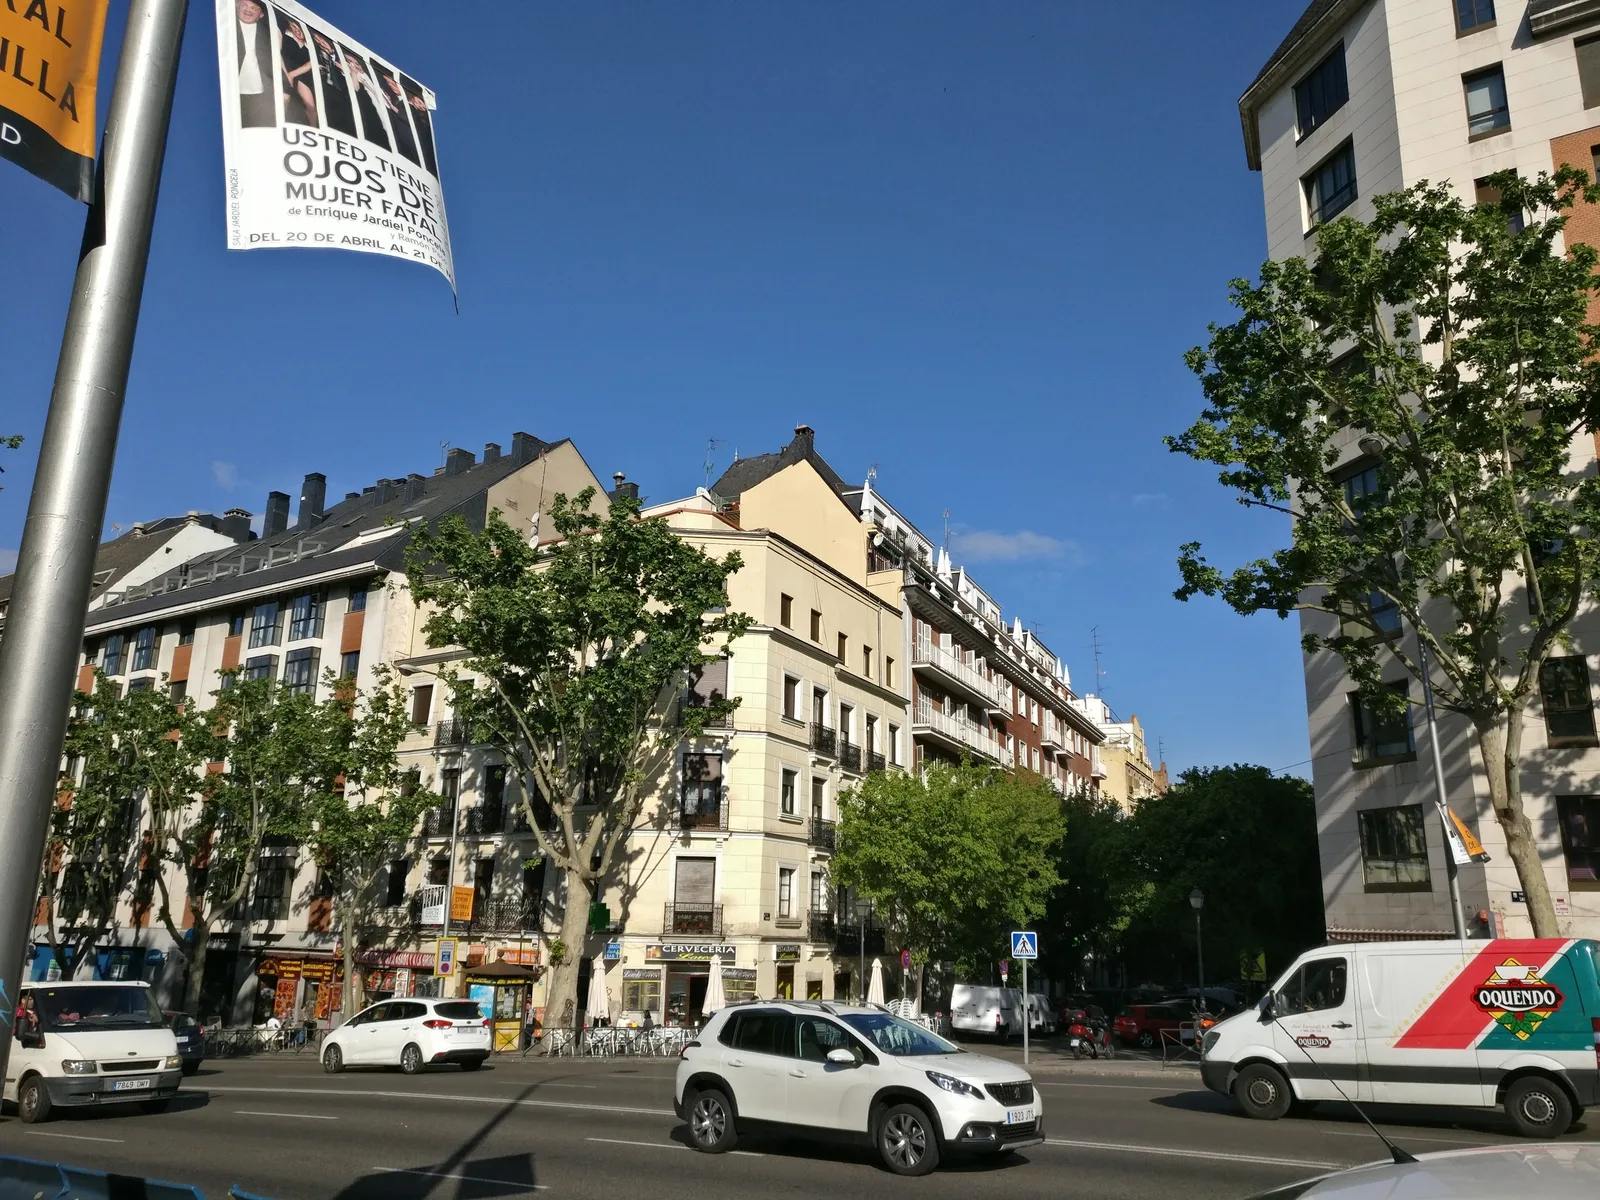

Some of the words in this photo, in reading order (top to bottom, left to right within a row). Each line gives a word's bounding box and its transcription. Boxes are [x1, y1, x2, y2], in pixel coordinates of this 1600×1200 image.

[282, 127, 368, 163] USTED
[375, 156, 433, 200] TIENE
[230, 168, 239, 199] PONCELA
[283, 150, 386, 194] OJOS
[398, 183, 438, 224] DE
[285, 181, 373, 210] MUJER
[382, 199, 442, 243] FATAL
[288, 207, 302, 216] de
[305, 205, 358, 222] Enrique
[362, 213, 404, 232] Jardiel
[407, 226, 446, 257] Poncela
[398, 230, 430, 249] Ramón
[249, 232, 281, 243] DEL
[286, 232, 308, 242] 20
[314, 233, 335, 243] DE
[341, 235, 386, 250] ABRIL
[390, 244, 409, 255] AL
[413, 249, 426, 260] 21
[430, 255, 444, 270] DE
[662, 945, 735, 954] CERVECERIA
[1479, 990, 1556, 1010] OQUENDO
[1299, 1038, 1329, 1047] OQUENDO
[1012, 1111, 1025, 1122] 1923
[1025, 1109, 1034, 1120] JTS
